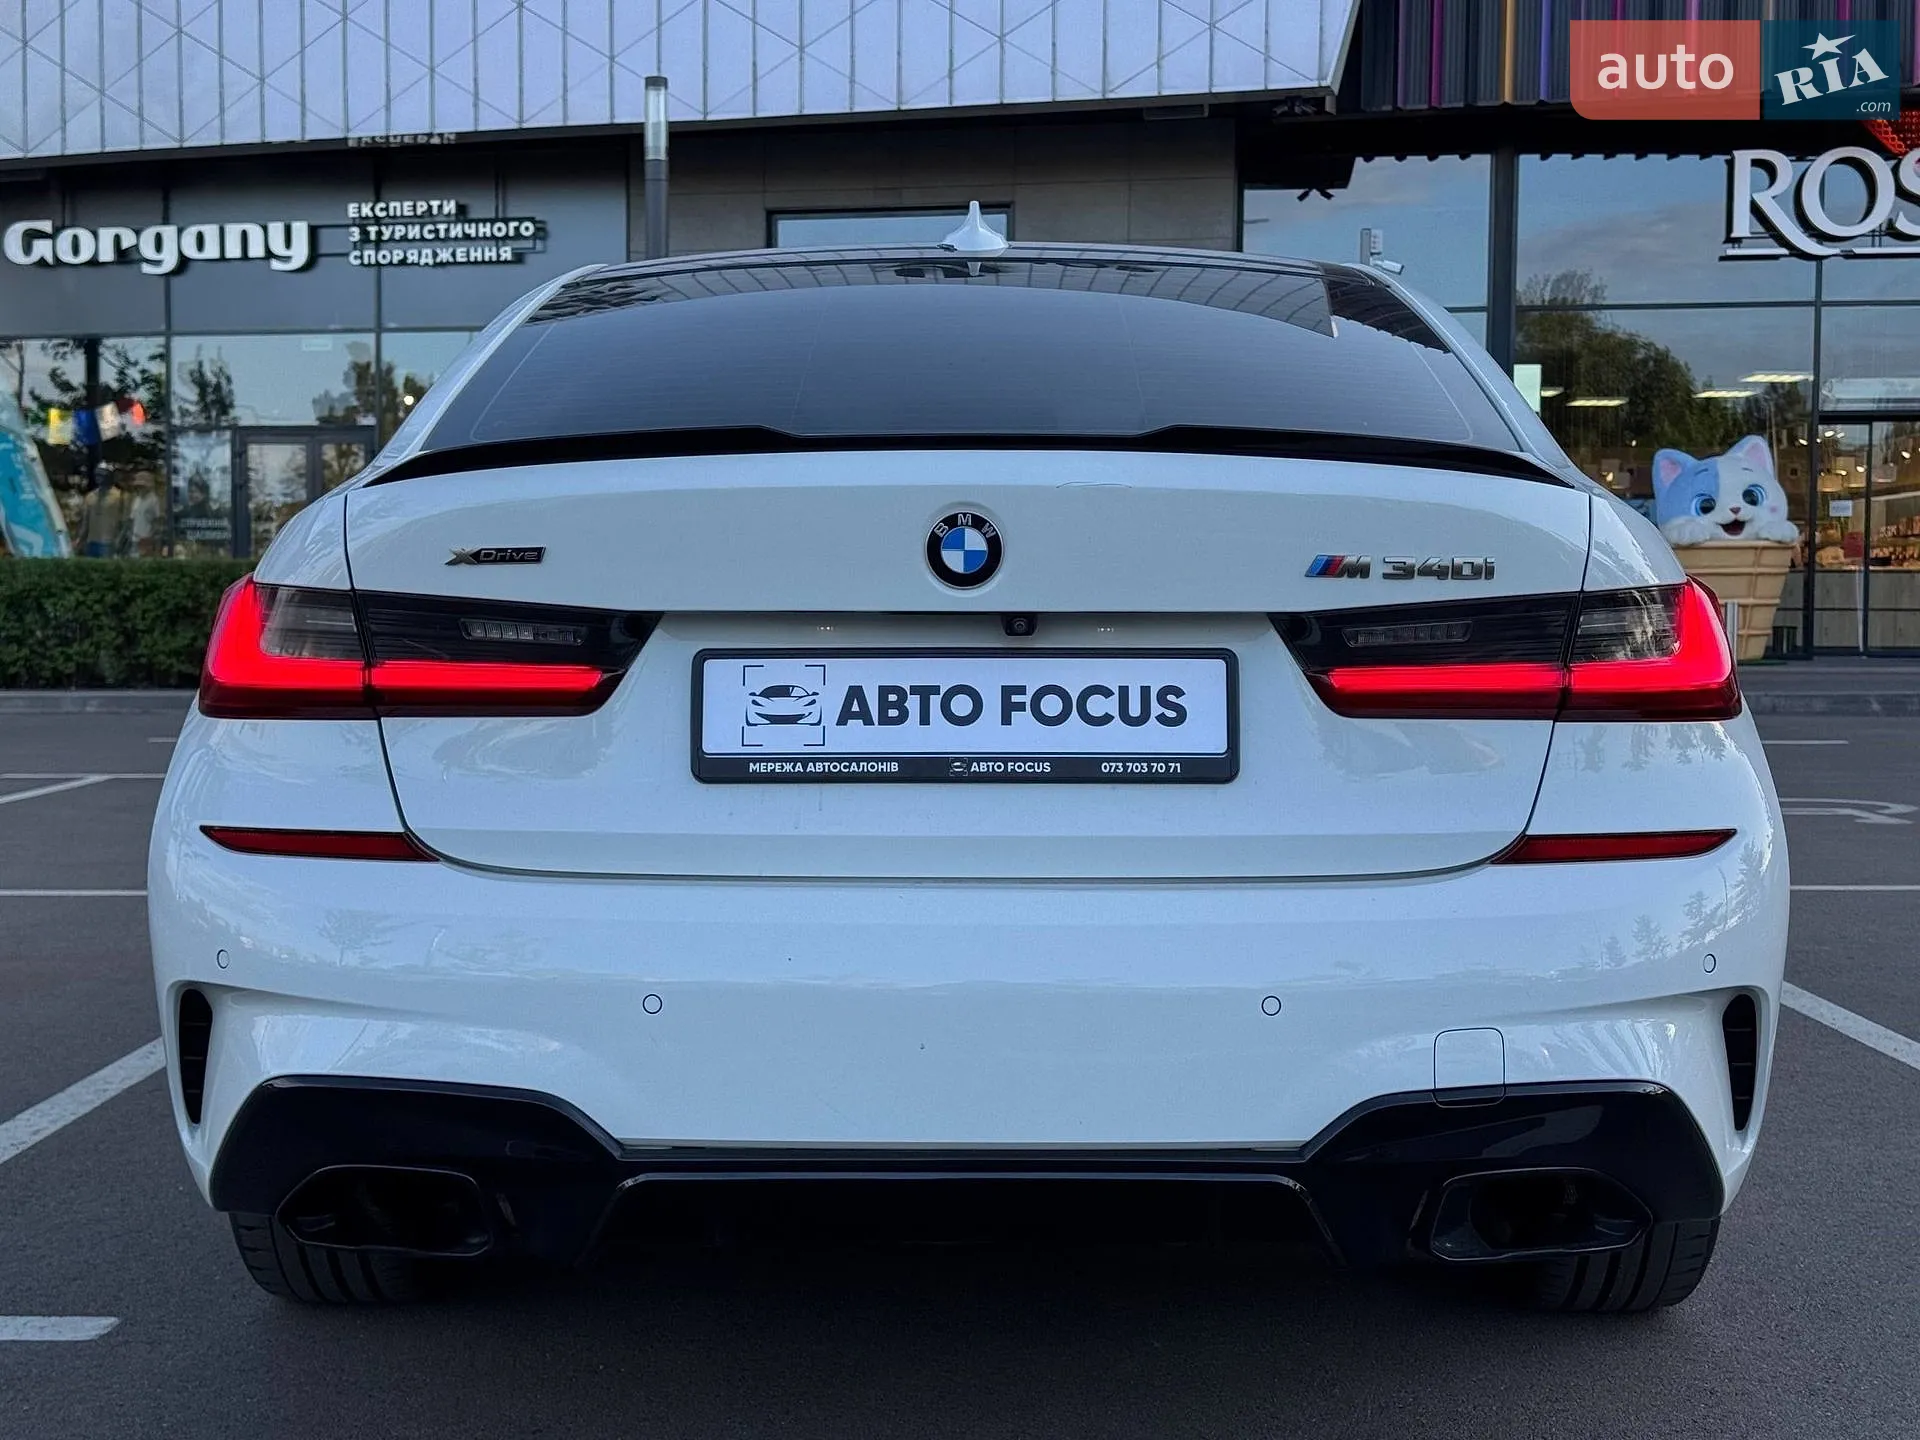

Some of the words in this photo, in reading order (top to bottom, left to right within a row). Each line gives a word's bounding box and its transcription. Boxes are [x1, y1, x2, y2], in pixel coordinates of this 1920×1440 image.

[347, 200, 456, 218] ЕКСПЕРТИ
[366, 221, 535, 241] ТУРИСТИЧНОГО
[4, 219, 309, 275] Gorgany
[349, 246, 513, 265] СПОРЯДЖЕННЯ
[934, 513, 996, 538] BMW
[1330, 554, 1371, 579] M
[1382, 556, 1495, 580] 340i
[835, 684, 984, 727] АВТО
[1000, 684, 1188, 727] FOCUS
[749, 762, 803, 773] МЕРЕЖА
[806, 762, 899, 773] АВТОСАЛОНІВ
[970, 762, 1004, 773] АВТО
[1007, 762, 1051, 773] FOCUS
[1101, 762, 1123, 773] 073
[1126, 762, 1148, 773] 703
[1150, 763, 1166, 773] 70
[1168, 763, 1181, 773] 71
